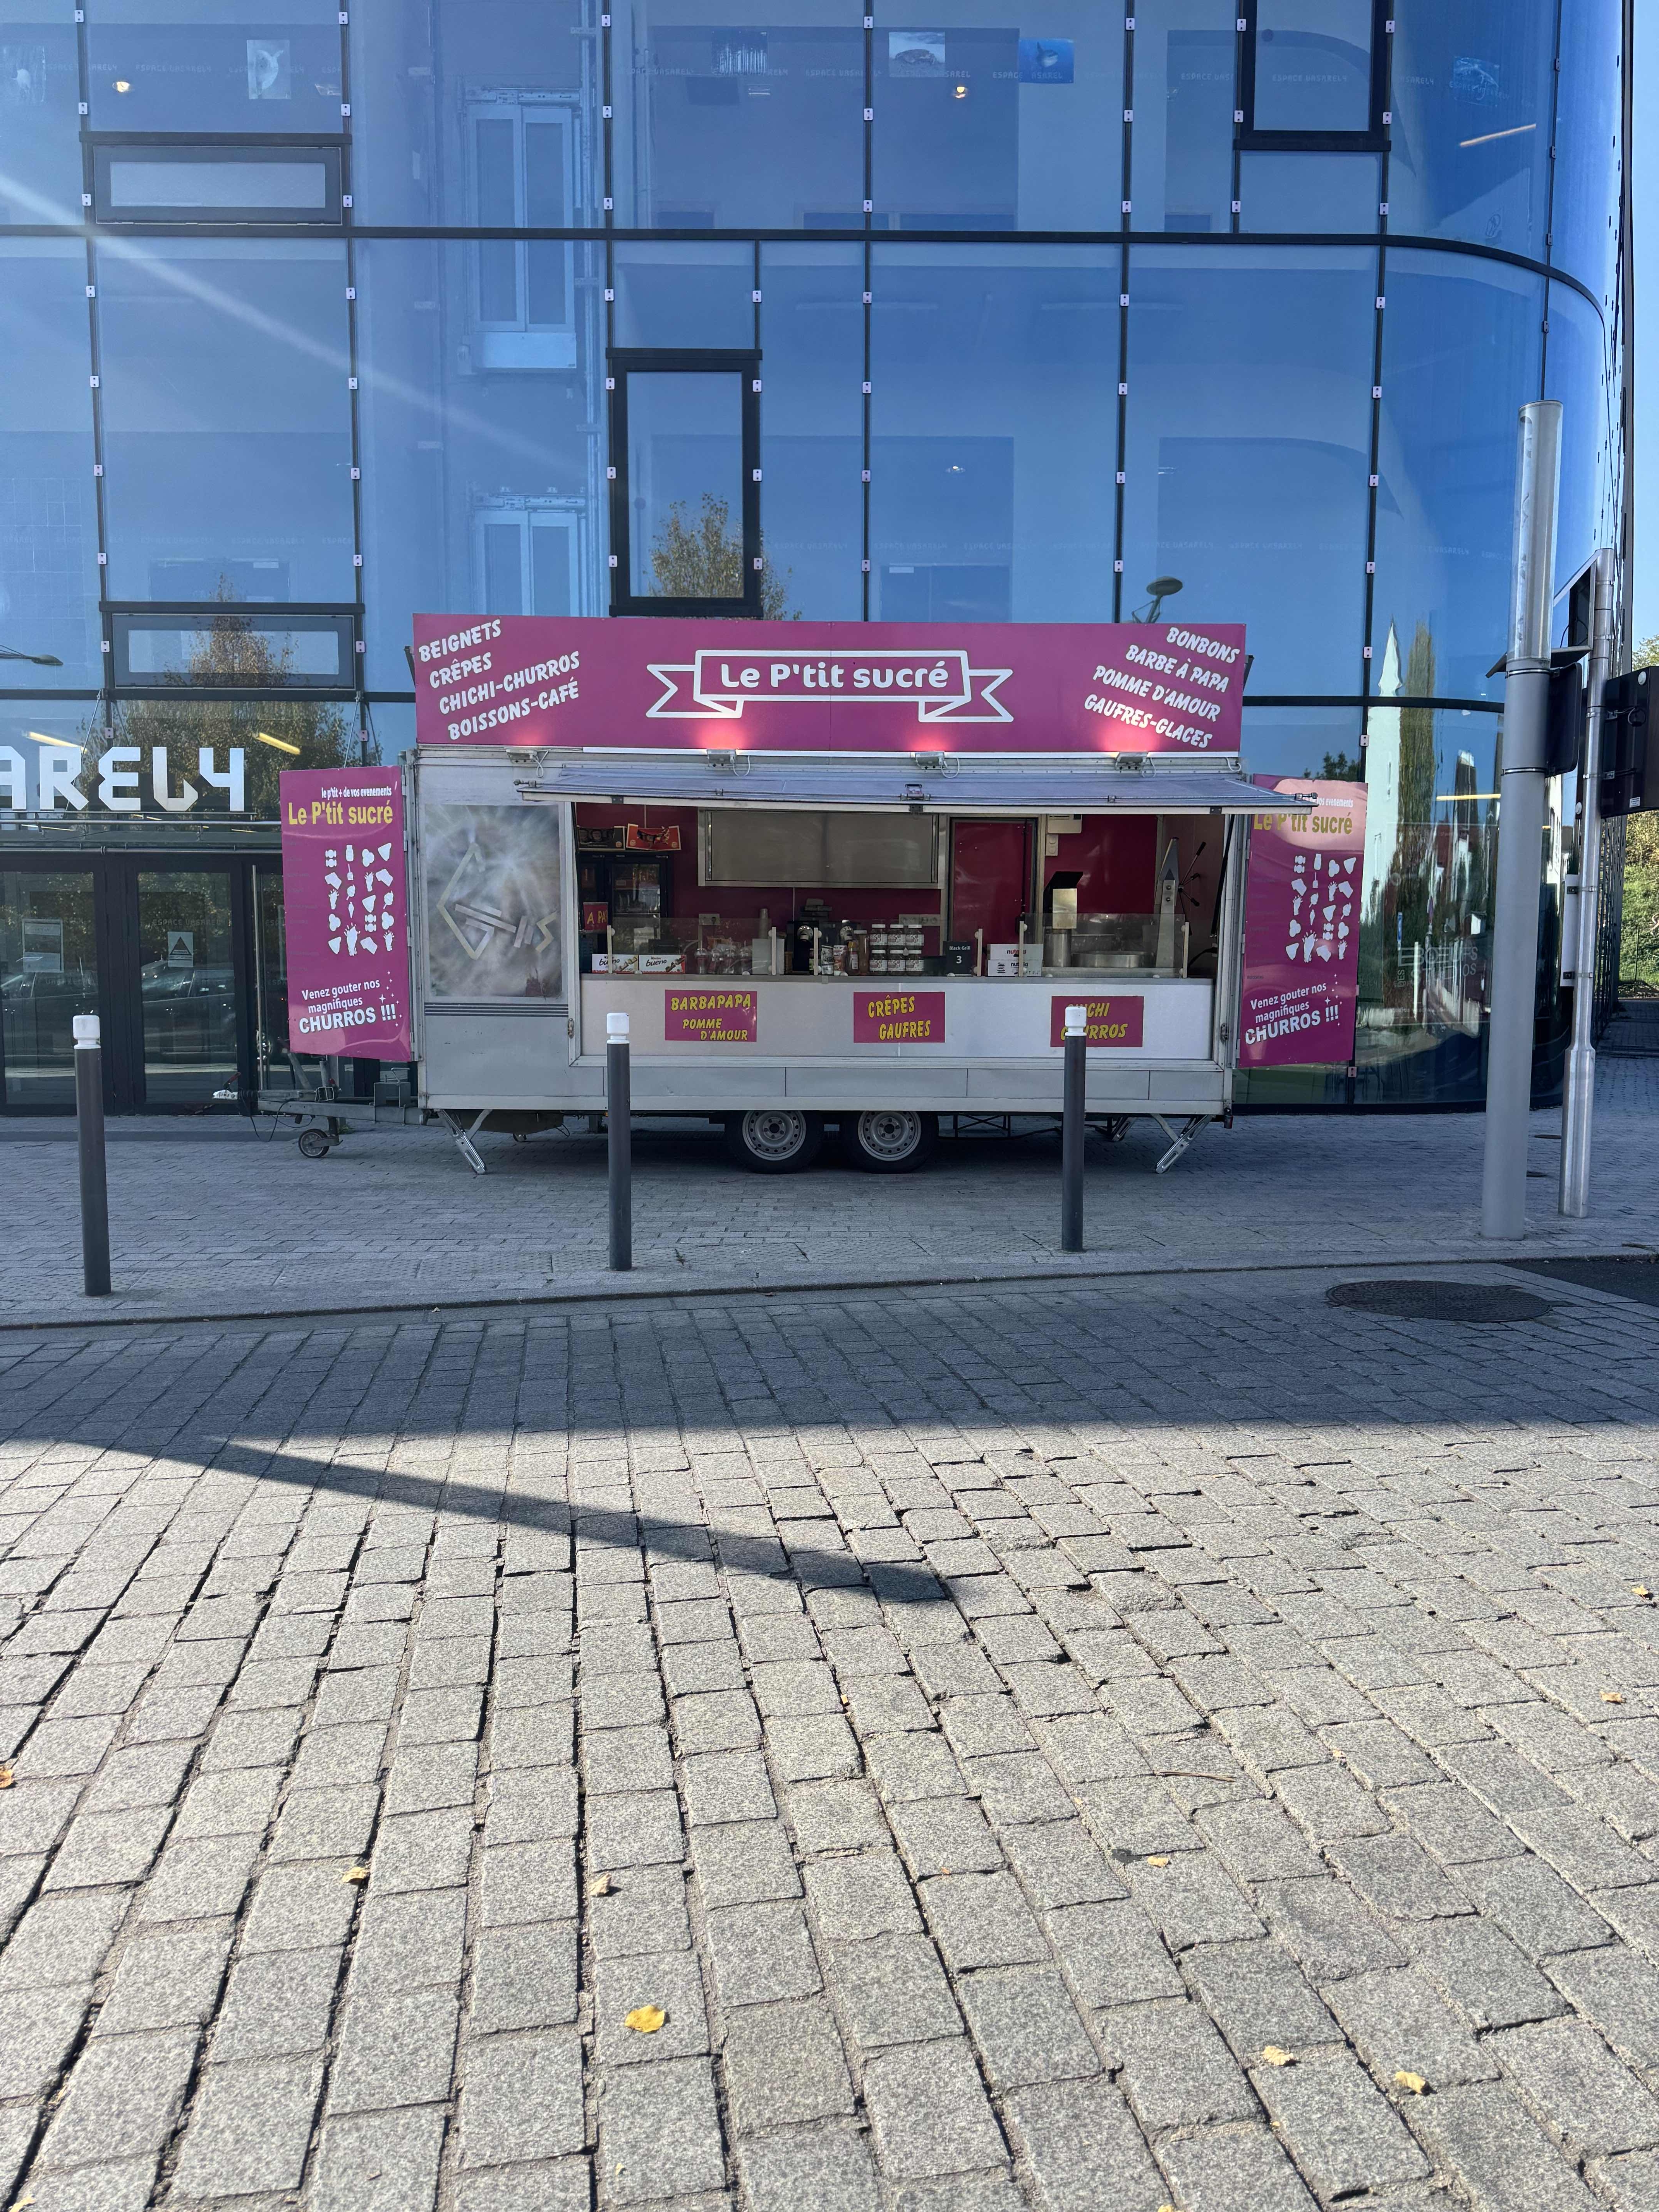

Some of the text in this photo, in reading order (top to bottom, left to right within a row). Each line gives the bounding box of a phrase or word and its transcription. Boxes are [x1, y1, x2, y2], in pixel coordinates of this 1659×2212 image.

[418, 619, 502, 663] BEIGNETS
[1166, 626, 1240, 664] BONBONS
[429, 652, 493, 689] CRÊPES
[721, 660, 949, 689] Le P'tit sucré
[1125, 644, 1230, 694] BARBE À PAPA
[439, 651, 580, 715] CHICHI-CHURROS
[1092, 665, 1221, 722] POMME D'AMOUR
[448, 676, 580, 740] BOISSONS-CAFÉ
[1084, 694, 1213, 749] GAUFRES-GLACES
[321, 787, 326, 798] le
[327, 787, 338, 800] p'tit
[343, 786, 350, 797] de
[351, 789, 360, 797] vos
[361, 786, 392, 797] evenements
[289, 800, 393, 825] Le P'tit sucré
[1254, 814, 1272, 831] Le
[1312, 812, 1352, 835] sucré
[587, 912, 594, 924] A
[956, 955, 962, 963] 3
[301, 979, 380, 1000] Venez gouter nos
[1250, 982, 1327, 1010] Venez gouter nos
[308, 997, 363, 1014] magnifiques
[671, 994, 751, 1011] BARBAPAPA
[867, 994, 915, 1018] CRÊPES
[1255, 1001, 1309, 1024] magnifiques
[299, 1003, 396, 1034] CHURROS !!!
[683, 1018, 723, 1029] POMME
[879, 1020, 931, 1041] GAUFRES
[1245, 1005, 1338, 1045] CHURROS !!!
[700, 1029, 748, 1041] D'AMOUR
